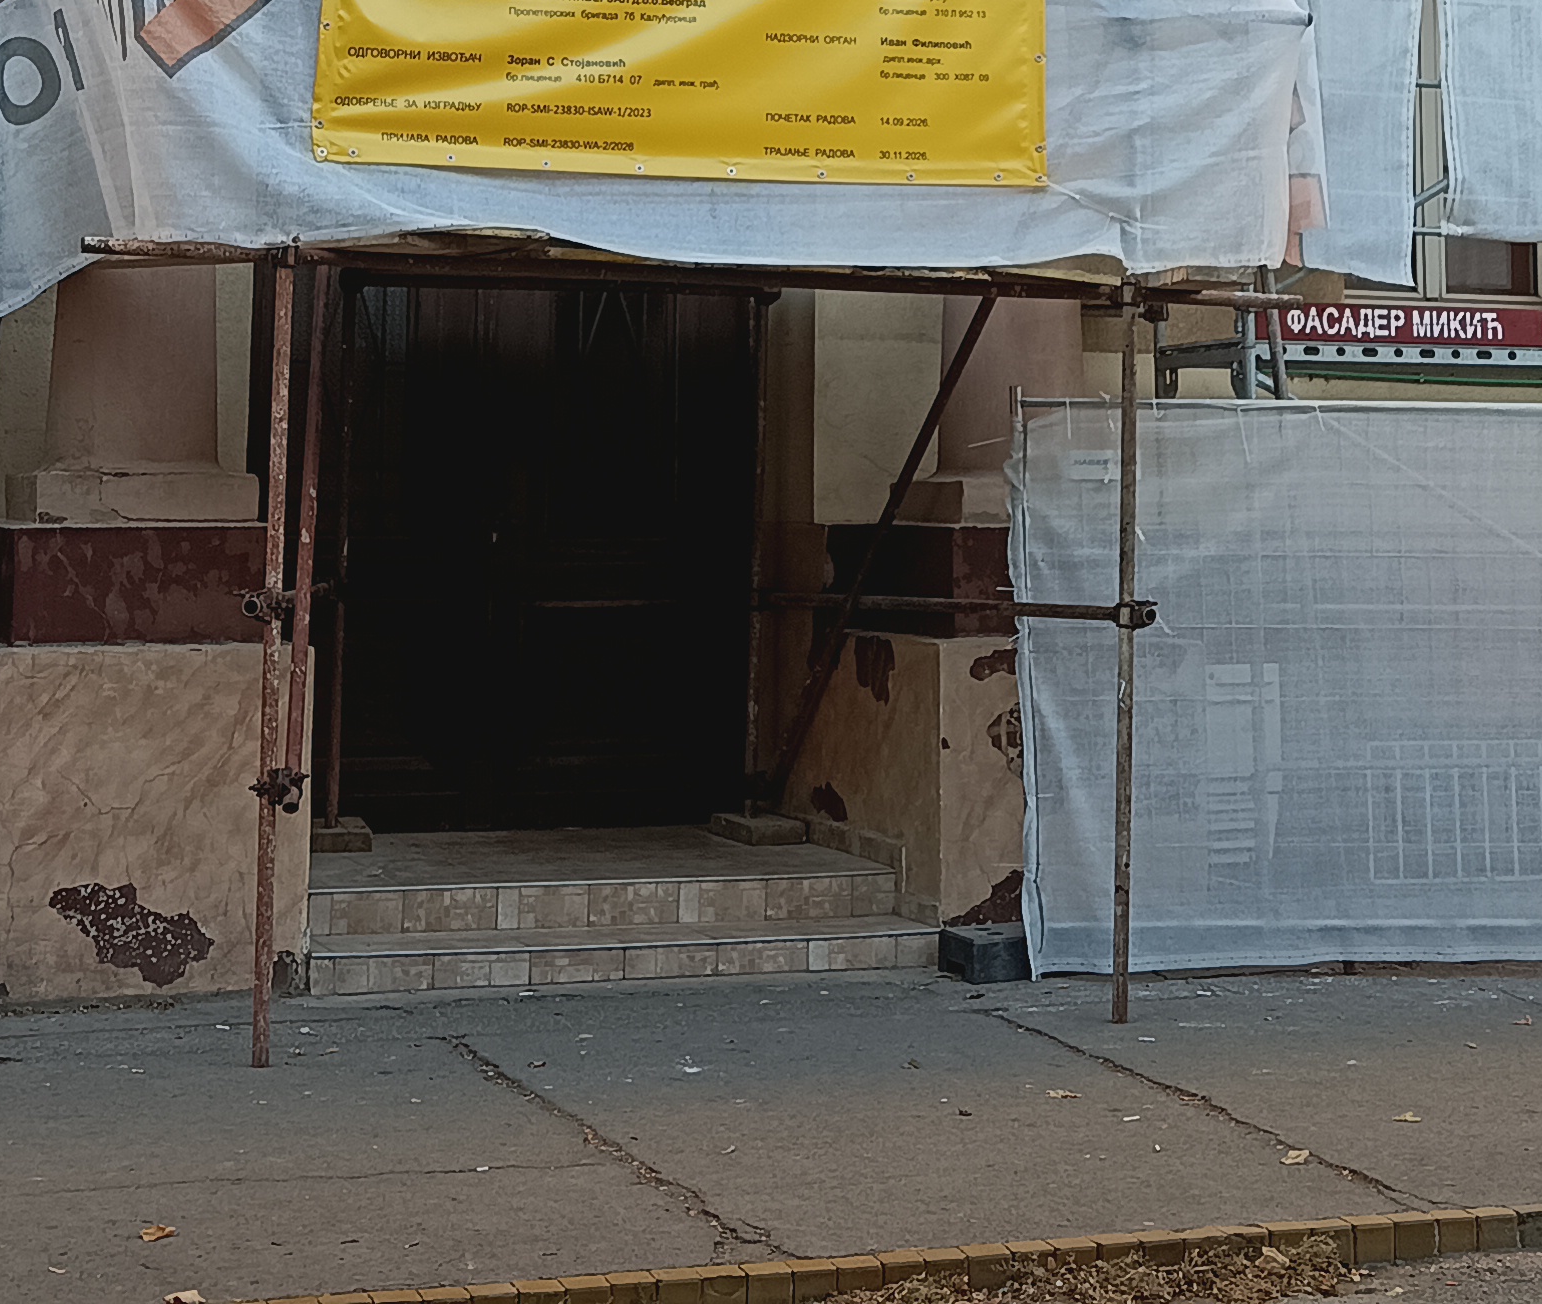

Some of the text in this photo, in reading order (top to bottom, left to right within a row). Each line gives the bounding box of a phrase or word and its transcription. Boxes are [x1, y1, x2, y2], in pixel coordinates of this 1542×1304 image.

[580, 8, 620, 23] бригада
[976, 9, 987, 19] 13
[765, 32, 857, 45] НАДЗОРНИ ОРГАН
[879, 36, 973, 50] Иван Филиповић
[347, 46, 483, 64] ОДГОВОРНИ ИЗВОЂАЧ
[506, 54, 542, 69] Зоран
[560, 56, 627, 71] Стојановић
[575, 73, 596, 84] 410
[628, 75, 643, 86] 07
[934, 71, 950, 81] 300
[978, 73, 990, 83] 09
[334, 95, 483, 113] ОДОБРЕЊЕ ЗА ИЗГРАДЊУ
[765, 112, 857, 126] ПОЧЕТАК РАДОВА
[380, 130, 480, 146] ПРИЈАВА РАДОВА
[763, 146, 856, 160] ТРАЈАЊЕ РАДОВА
[1286, 306, 1406, 340] ФАСАДЕР
[1411, 310, 1504, 341] МИКИЋ
